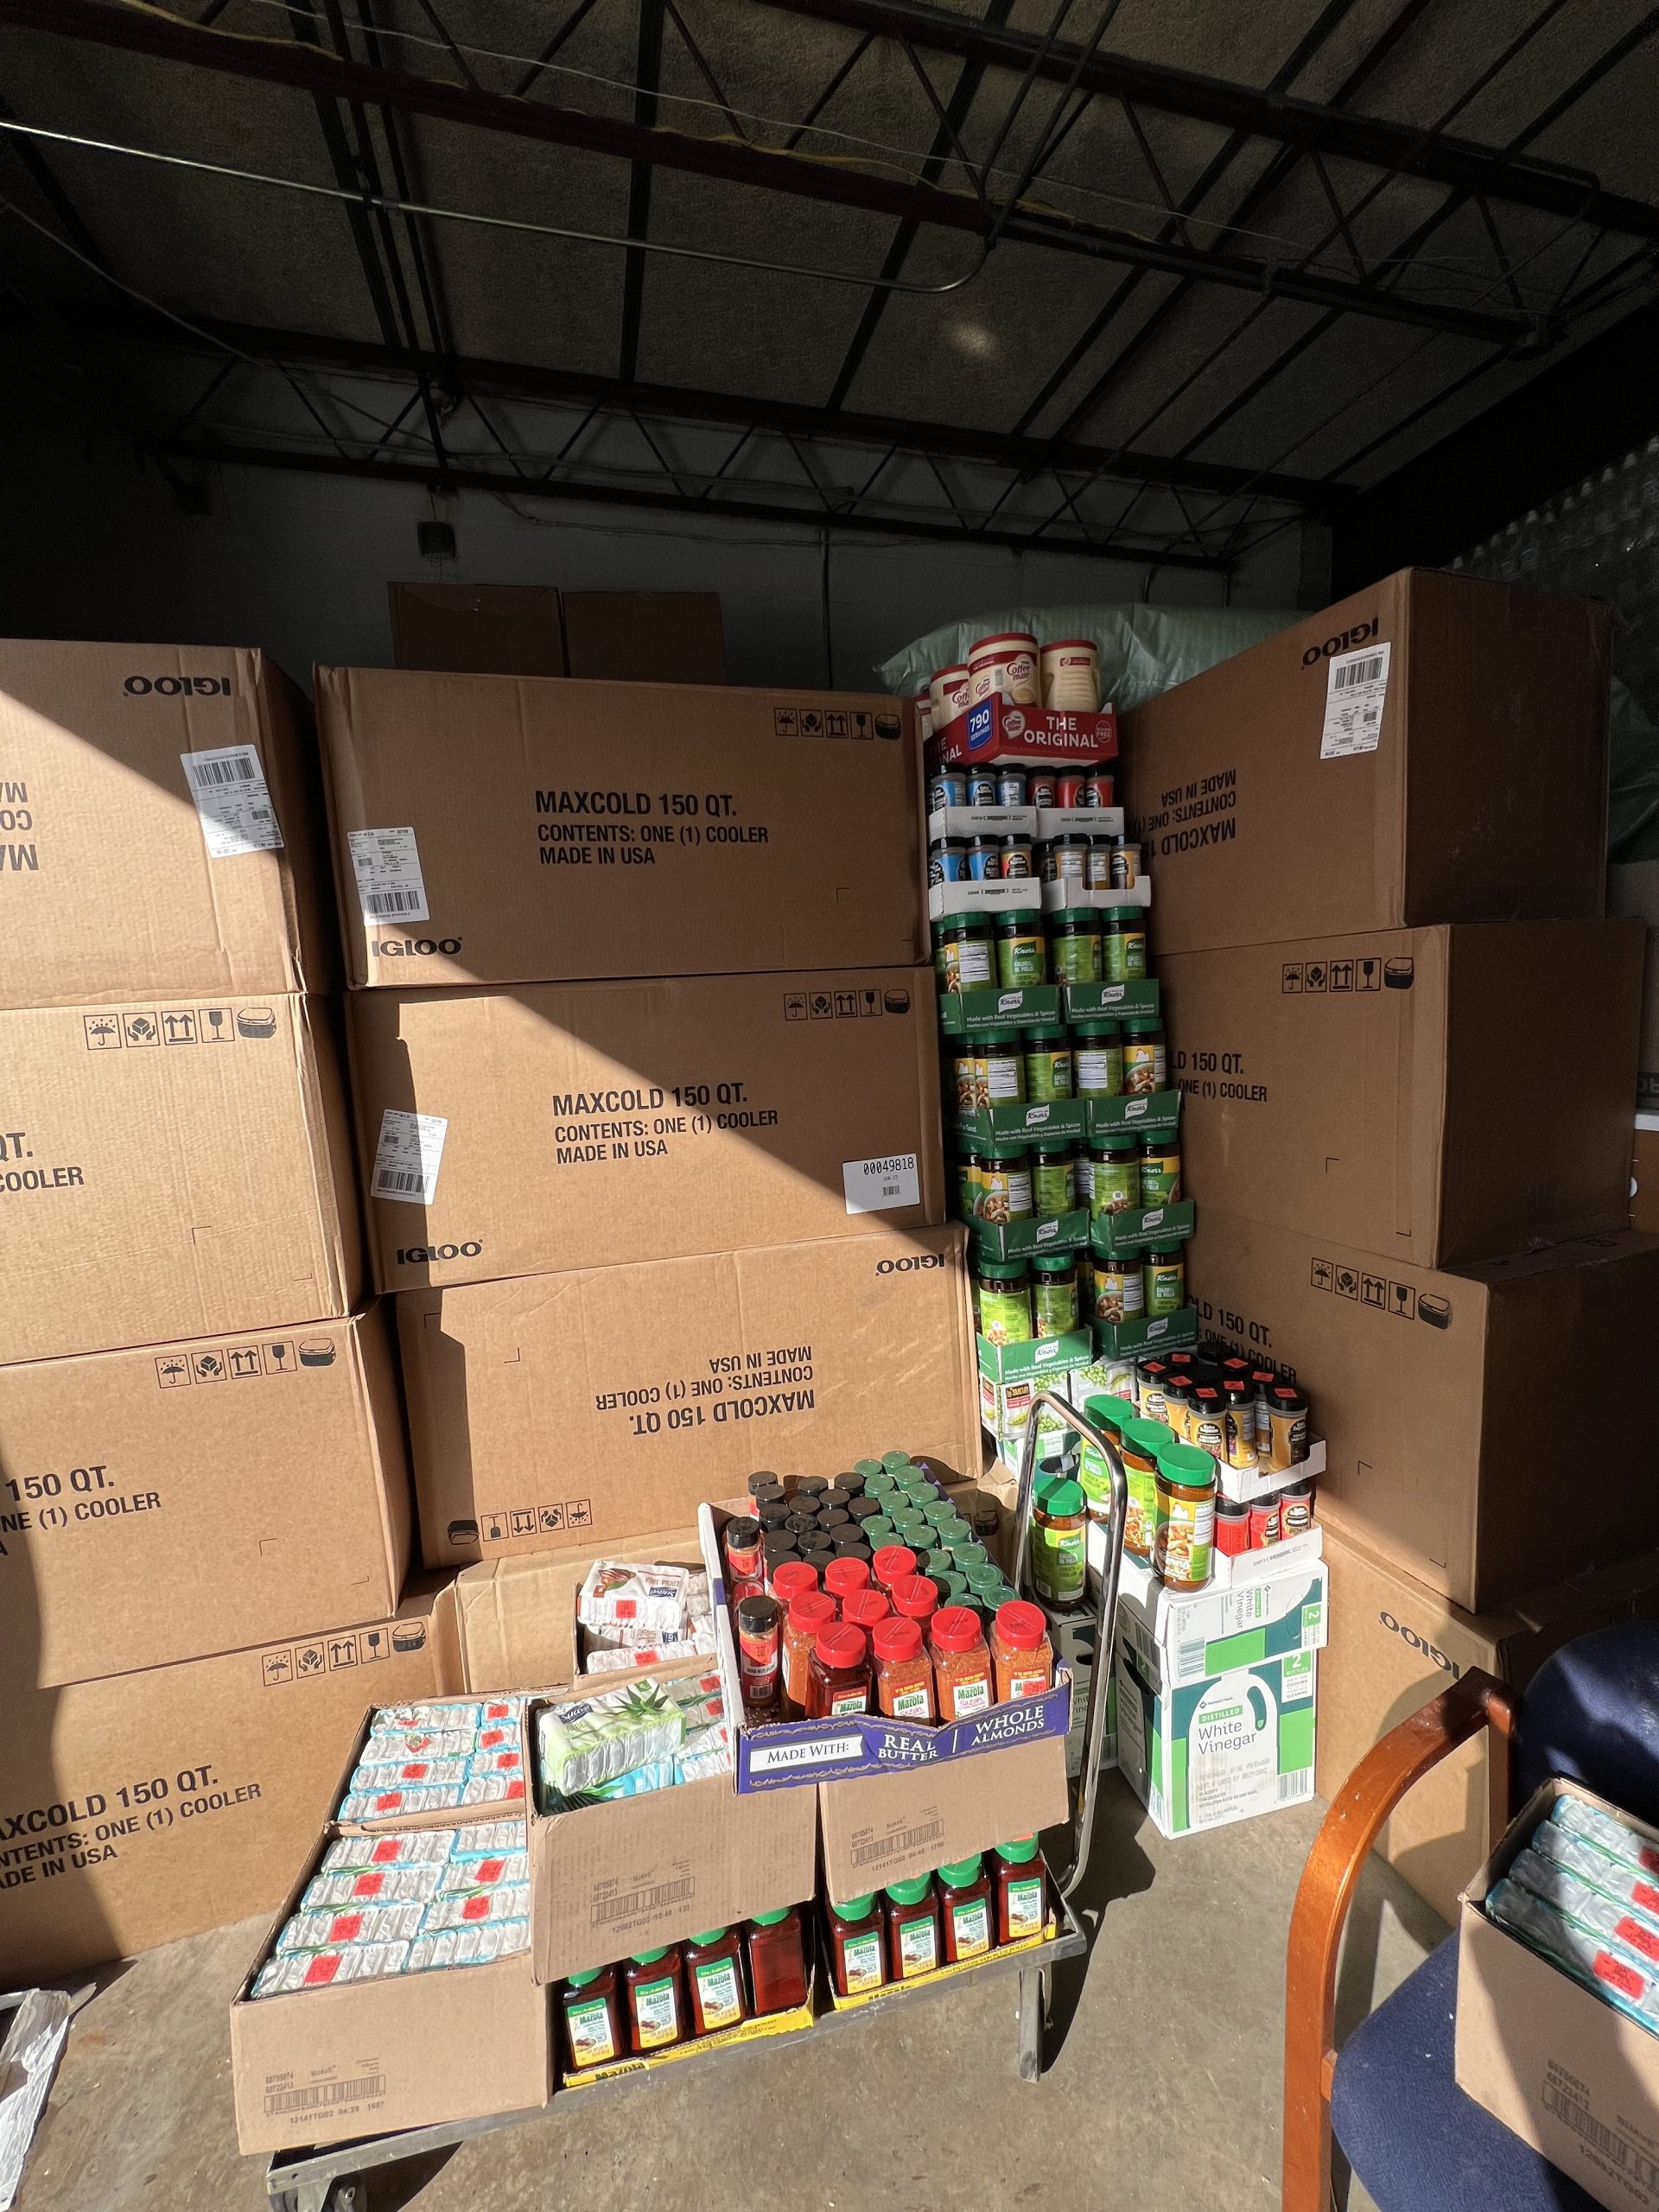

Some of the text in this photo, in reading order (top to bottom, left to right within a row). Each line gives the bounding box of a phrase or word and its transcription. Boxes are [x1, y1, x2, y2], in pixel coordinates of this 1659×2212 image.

[1303, 617, 1378, 666] IGLOO
[1007, 662, 1031, 677] Coffee
[1013, 671, 1030, 682] mate
[124, 676, 231, 696] IGLOO
[969, 709, 989, 733] 790
[1046, 715, 1077, 730] THE
[1024, 729, 1098, 747] ORIGINAL
[1161, 769, 1236, 807] MADE IN USA
[536, 791, 737, 819] MAXCOLD 150 QT.
[1148, 791, 1236, 831] CONTENTS: ONE
[537, 823, 769, 847] CONTENTS: ONE (1) COOLER
[1161, 817, 1235, 855] MAXCOLD
[539, 845, 656, 865] MADE IN USA
[372, 938, 461, 957] IGLOO
[1000, 997, 1022, 1007] Knorr
[1191, 1052, 1217, 1071] 150
[1222, 1053, 1243, 1074] QT.
[553, 1082, 747, 1116] MAXCOLD 150 QT.
[1179, 1079, 1267, 1102] ONE (1) COOLER
[1027, 1111, 1050, 1120] Knorr
[555, 1109, 779, 1143] CONTENTS: ONE (1) COOLER
[556, 1140, 668, 1165] MADE IN USA
[863, 1157, 914, 1175] 00049818
[397, 1243, 480, 1265] IGLOO
[876, 1254, 945, 1274] IGLOO
[1217, 1309, 1243, 1334] 150
[1249, 1321, 1272, 1348] QT.
[709, 1346, 811, 1373] MADE IN USA
[1037, 1347, 1058, 1357] Knorr
[1248, 1349, 1296, 1382] COOLER
[595, 1366, 813, 1409] CONTENTS: ONE (1) COOLER
[629, 1389, 815, 1435] MAXCOLD 150 QT.
[5, 1465, 114, 1502] 150 QT.
[39, 1507, 67, 1530] (1)
[74, 1491, 162, 1521] COOLER
[1058, 1537, 1080, 1547] Knorr
[1235, 1591, 1245, 1629] Vinegar
[1244, 1589, 1254, 1618] White
[1308, 1610, 1320, 1618] 2
[1380, 1611, 1459, 1681] IGLOO
[1292, 1654, 1301, 1668] 2
[957, 1685, 984, 1700] Mazola
[840, 1700, 862, 1711] Mazola
[898, 1696, 924, 1711] Mazola
[976, 1706, 1044, 1733] WHOLE
[1202, 1707, 1240, 1722] DISTILLED
[971, 1718, 1045, 1745] ALMONDS
[1198, 1720, 1242, 1740] White
[883, 1733, 936, 1751] REAL
[1198, 1732, 1257, 1755] Vinegar
[767, 1742, 849, 1763] MADE WITH:
[878, 1747, 938, 1761] BUTTER
[116, 1778, 168, 1808] 150
[176, 1765, 218, 1792] QT.
[95, 1816, 140, 1840] ONE
[146, 1808, 173, 1830] (1)
[180, 1783, 262, 1818] COOLER
[887, 1819, 903, 1828] SUAVE
[42, 1859, 65, 1878] IN
[73, 1845, 118, 1869] USA
[1017, 1891, 1038, 1902] Mazola
[963, 1912, 983, 1925] Mazola
[909, 1929, 931, 1942] Mazola
[854, 1945, 875, 1957] Mazola
[707, 1974, 731, 1987] Mazola
[645, 1993, 670, 2006] Mazola
[579, 2012, 604, 2025] Mazola
[311, 2068, 333, 2076] SUAVE
